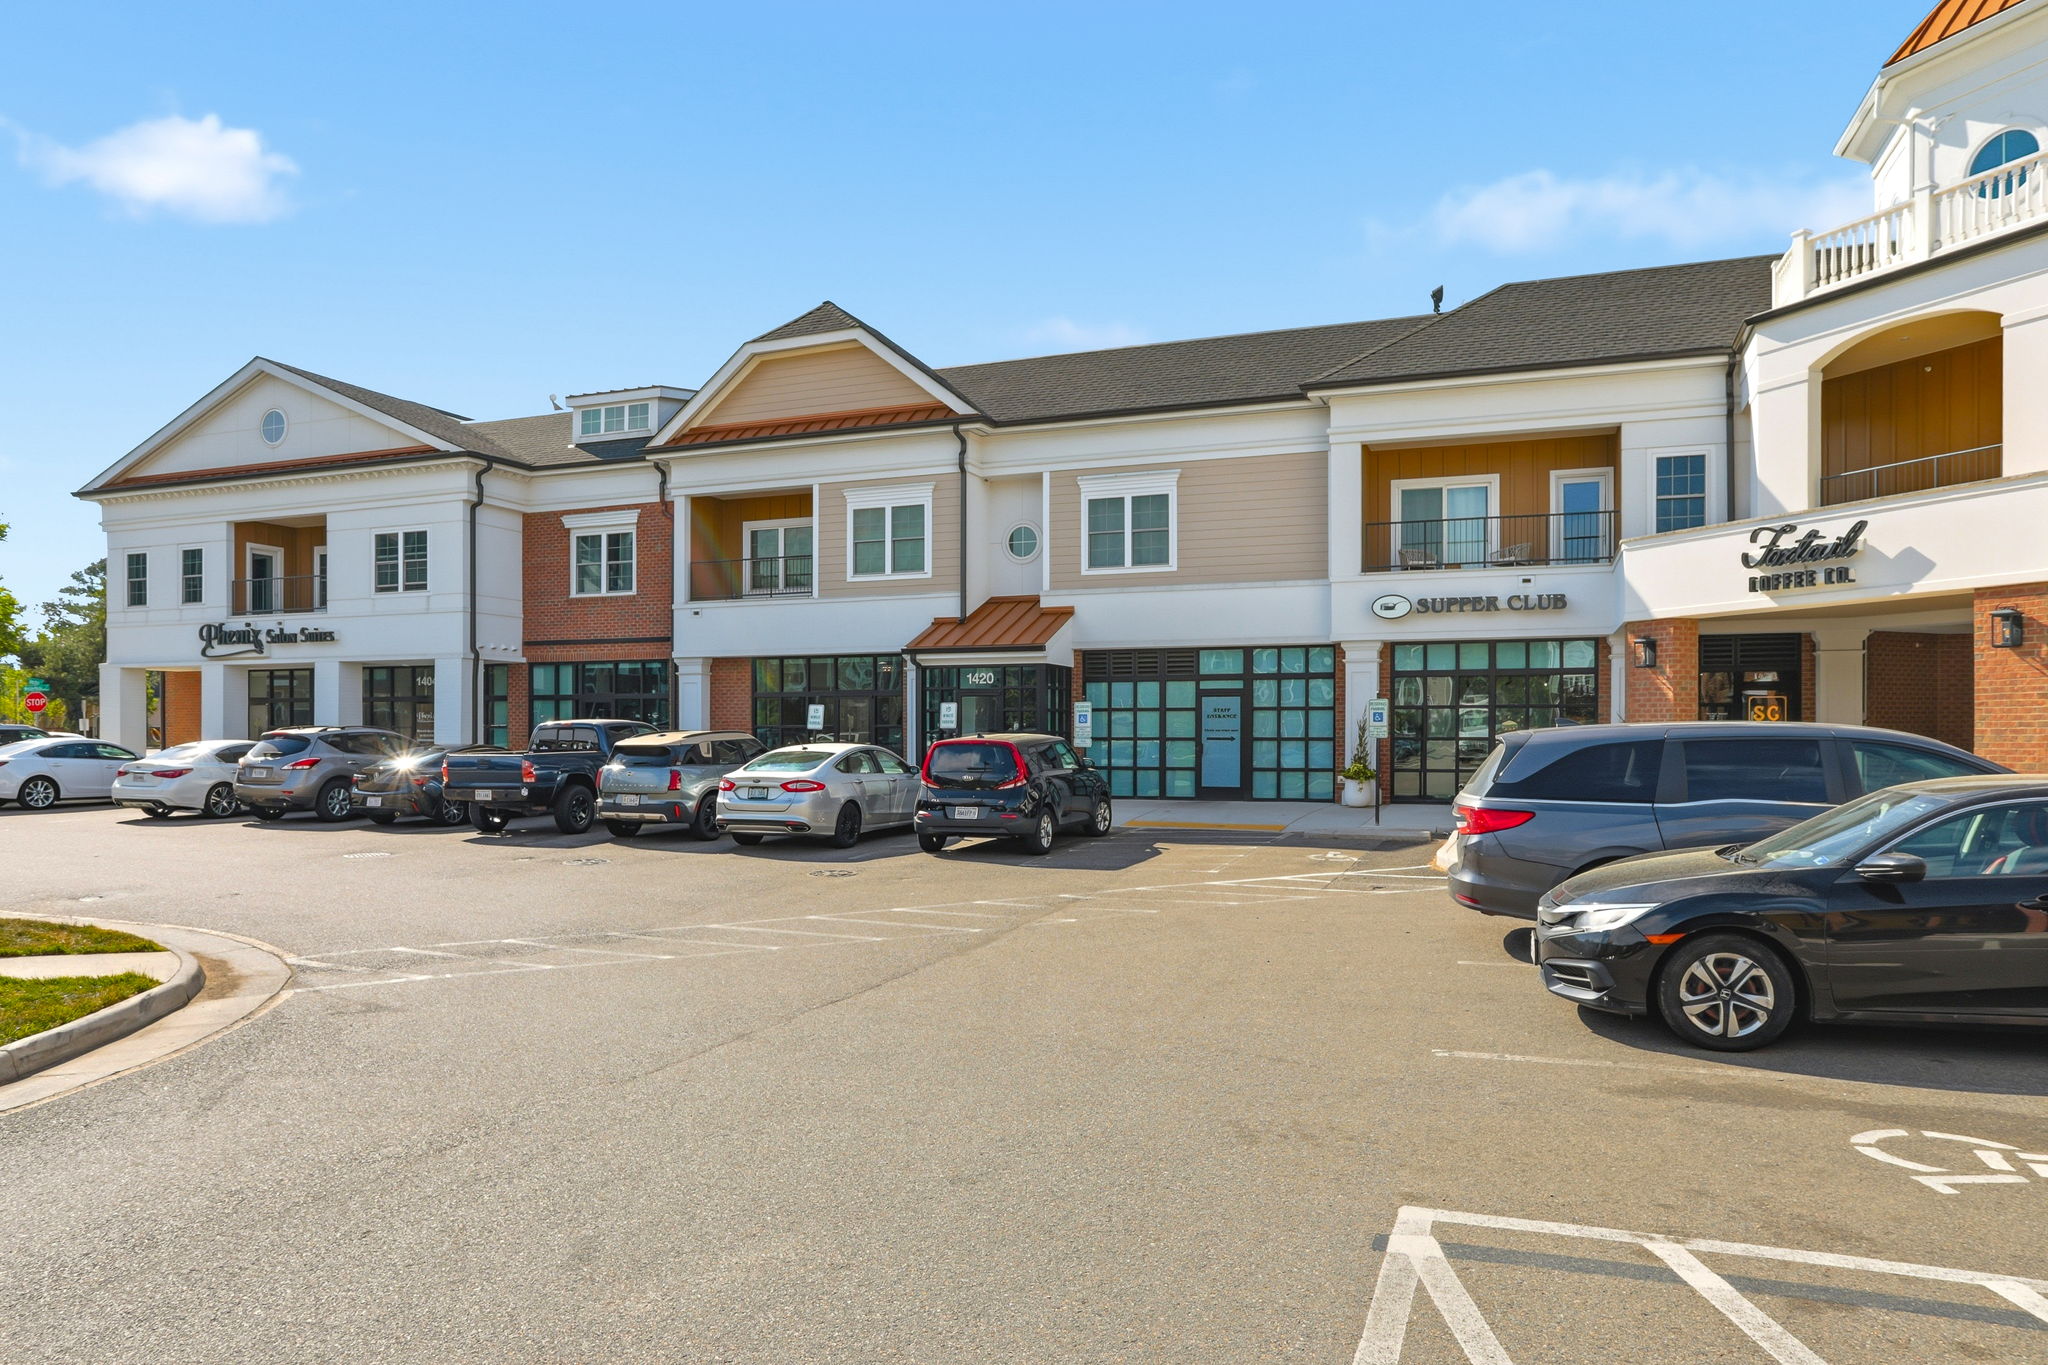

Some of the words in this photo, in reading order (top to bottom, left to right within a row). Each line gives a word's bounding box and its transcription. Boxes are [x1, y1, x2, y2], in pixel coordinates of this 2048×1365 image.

[1741, 519, 1868, 569] Foxtail
[1748, 569, 1816, 592] COFFEE
[1824, 566, 1856, 584] CO.
[1416, 596, 1500, 614] SUPPER
[1507, 593, 1568, 610] CLUB
[198, 622, 264, 658] Phenix
[266, 621, 298, 644] Salon
[300, 627, 336, 642] Suites
[966, 672, 994, 684] 1420
[26, 698, 46, 706] STOP
